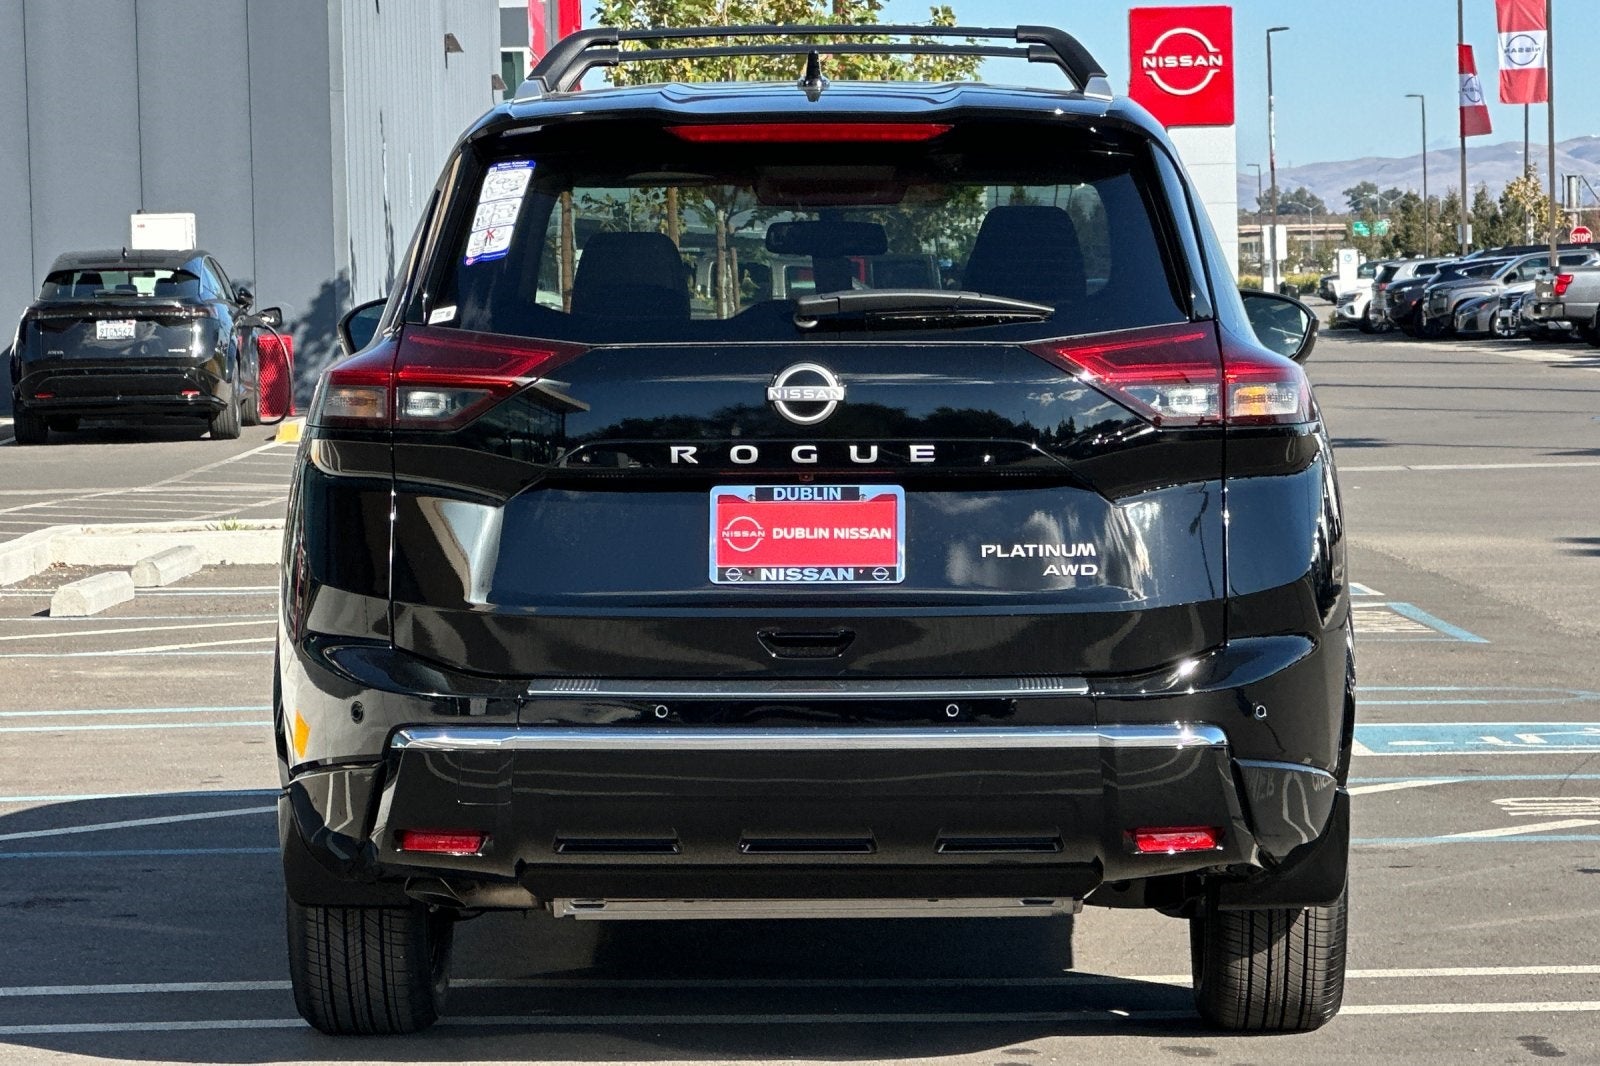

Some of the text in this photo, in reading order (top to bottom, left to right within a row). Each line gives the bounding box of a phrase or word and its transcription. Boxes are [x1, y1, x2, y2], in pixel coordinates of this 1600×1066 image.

[1142, 54, 1223, 68] NISSAN
[1571, 233, 1591, 243] STOP
[767, 387, 844, 399] NISSAN
[669, 445, 936, 465] ROGUE
[773, 487, 841, 501] DUBLIN
[772, 528, 892, 540] DUBLIN NISSAN
[981, 543, 1097, 558] PLATINUM
[760, 568, 854, 581] NISSAN
[1042, 564, 1098, 576] AWD
